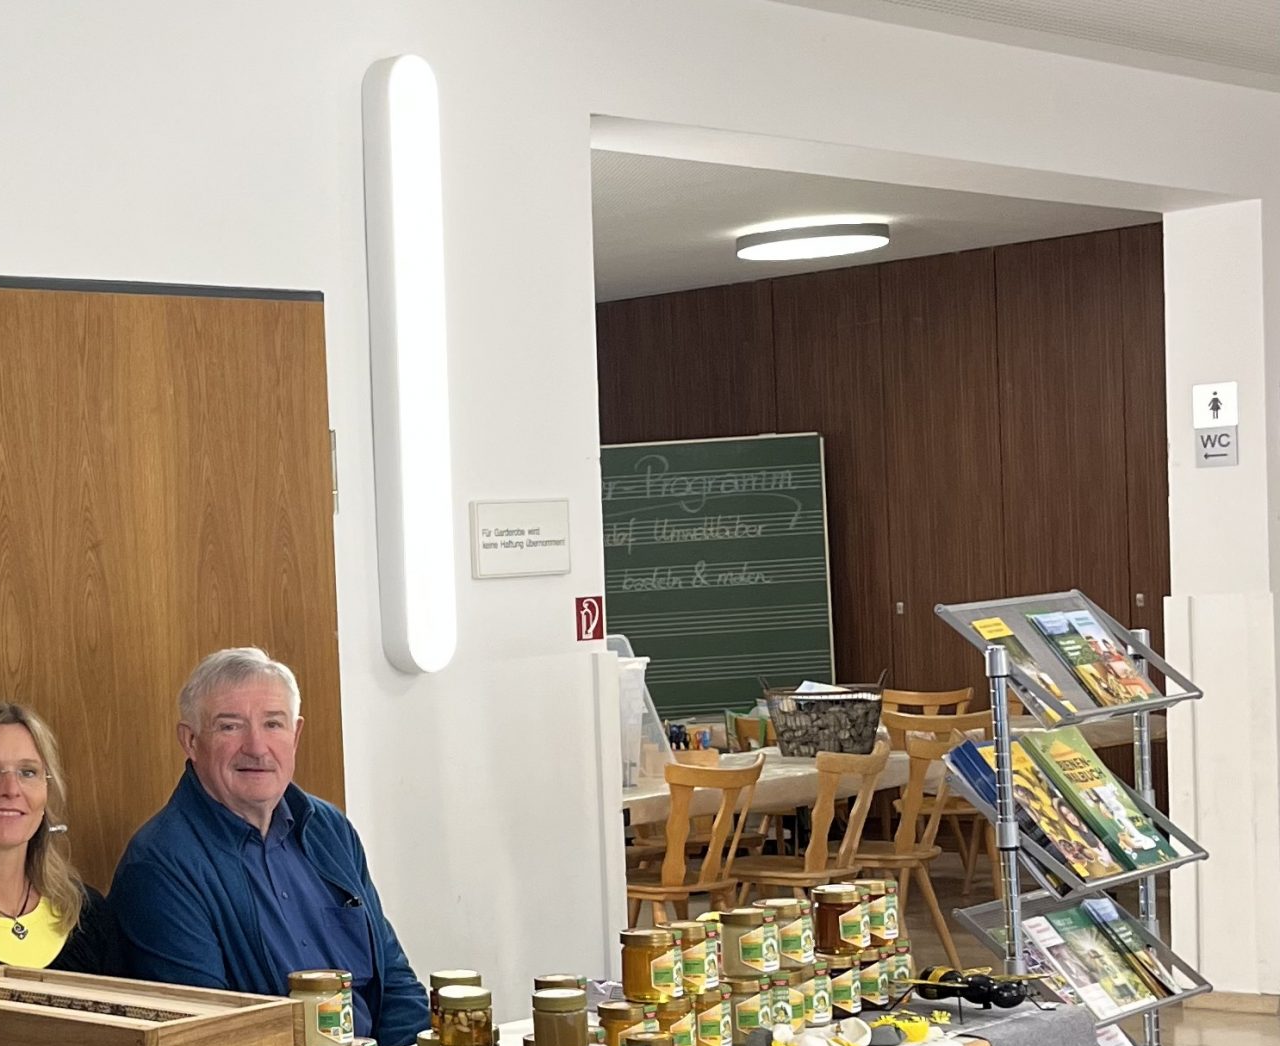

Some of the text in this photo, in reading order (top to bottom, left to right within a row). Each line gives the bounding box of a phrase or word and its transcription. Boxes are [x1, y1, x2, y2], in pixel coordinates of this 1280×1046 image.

[1200, 433, 1231, 449] WC
[481, 527, 541, 538] Für Garderobe wird
[482, 541, 499, 550] keine
[500, 540, 524, 550] Haftung
[692, 560, 709, 587] &
